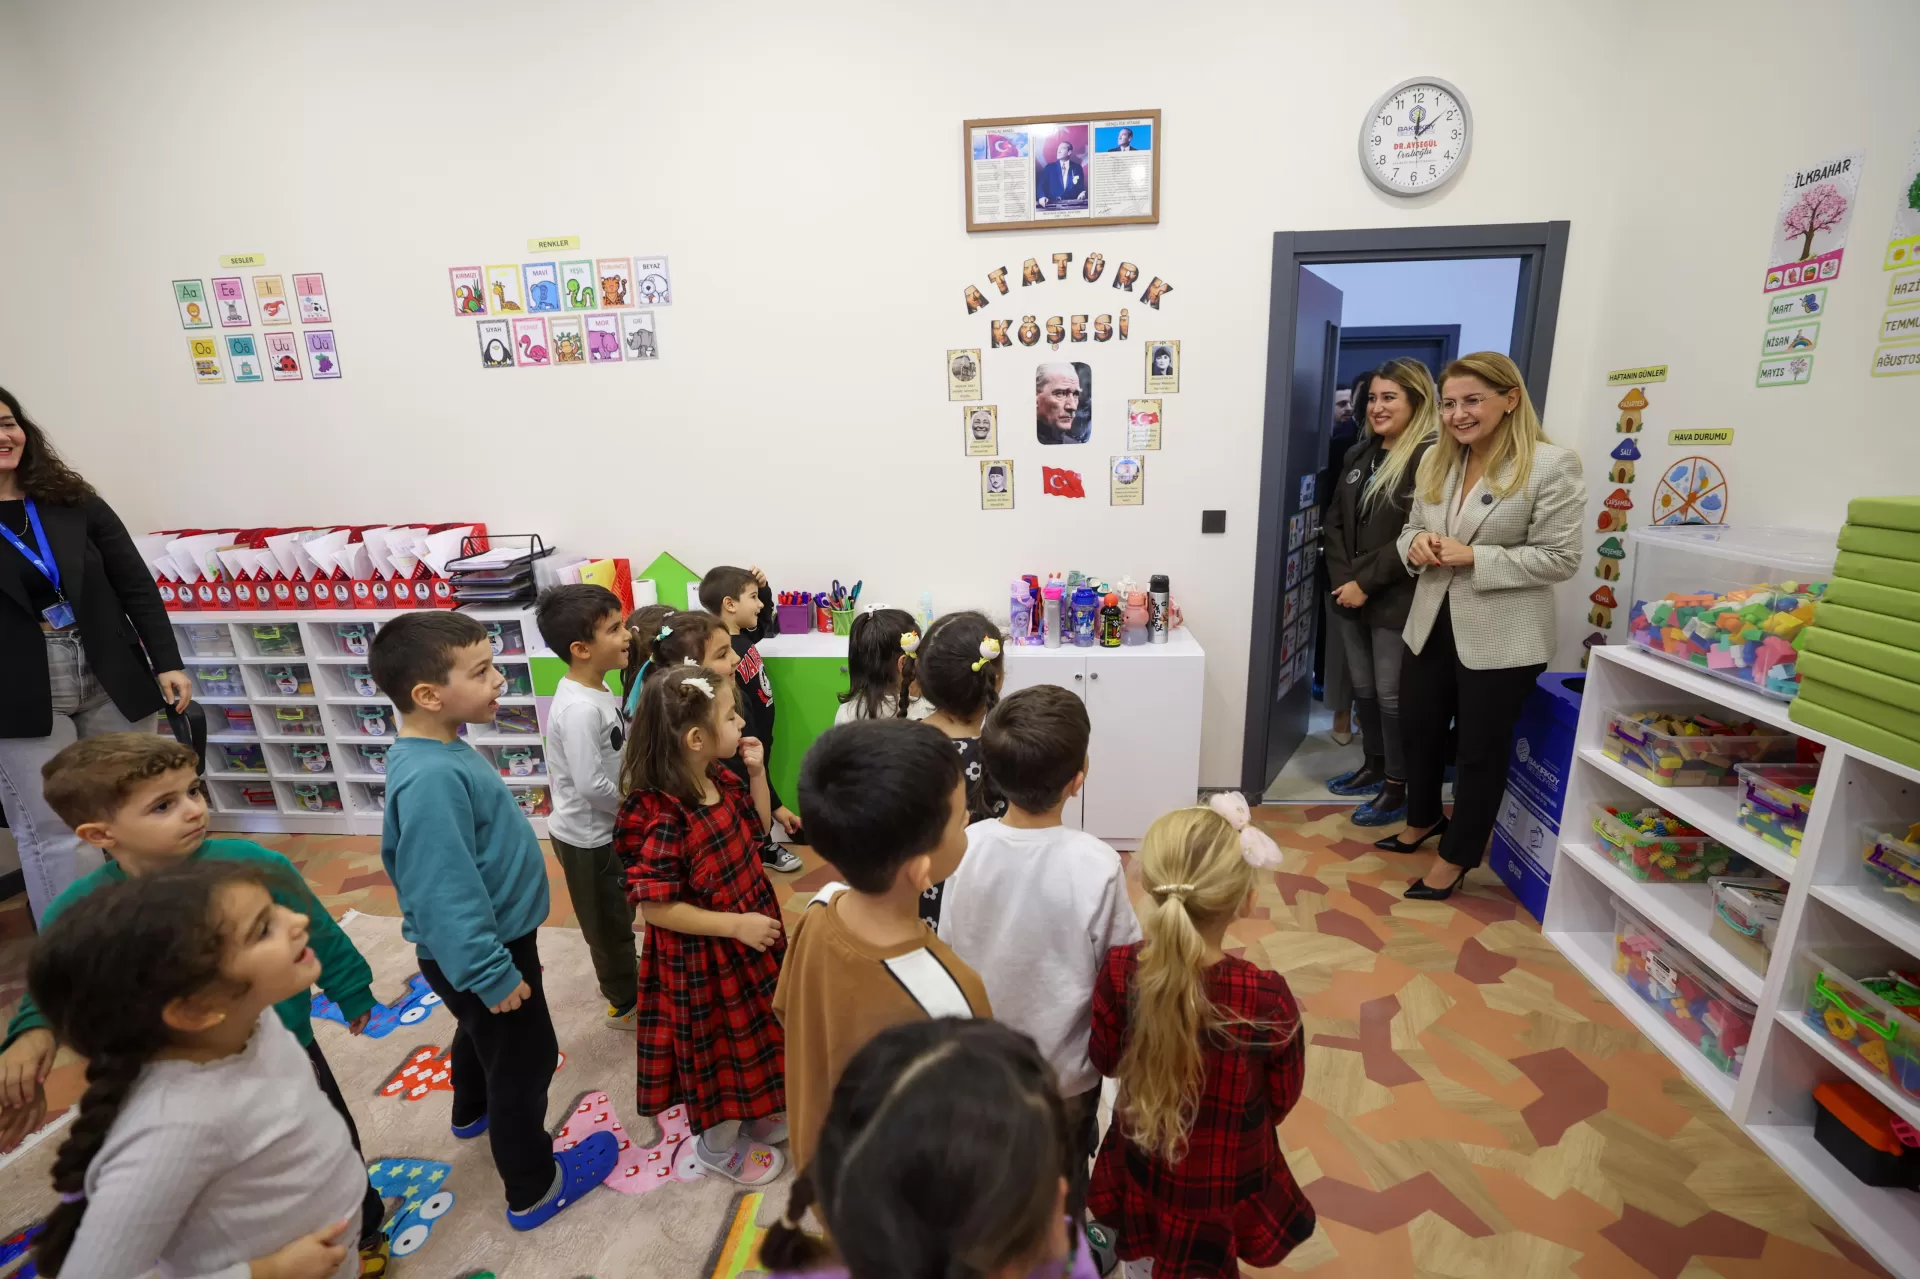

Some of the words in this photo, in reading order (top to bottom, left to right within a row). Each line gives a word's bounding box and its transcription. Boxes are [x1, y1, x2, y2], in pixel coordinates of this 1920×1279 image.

[1413, 93, 1425, 103] 12
[1396, 100, 1404, 110] 11
[1382, 115, 1392, 126] 10
[1446, 110, 1454, 121] 2
[1450, 129, 1458, 140] 3
[1374, 136, 1382, 146] 9
[1380, 154, 1386, 165] 8
[1444, 150, 1450, 160] 4
[1393, 168, 1400, 178] 7
[1428, 164, 1436, 174] 5
[1794, 159, 1852, 188] İLKBAHAR
[1410, 172, 1418, 182] 6
[538, 239, 569, 248] RENKLER
[963, 252, 1174, 315] ATATÜRK
[182, 286, 197, 298] Aa
[220, 283, 235, 296] Ee
[1771, 303, 1794, 315] MART
[990, 308, 1130, 351] KÖŞESİ
[234, 338, 250, 354] Öö
[272, 339, 290, 352] Uu
[312, 334, 330, 350] Üü
[1766, 334, 1790, 347] NİSAN
[195, 342, 212, 354] Oo
[1609, 372, 1639, 381] HAFTANIN
[1638, 368, 1666, 378] GÜNLERİ
[1760, 367, 1784, 378] MAYIS
[1620, 400, 1645, 408] PAZARTESİ
[1674, 433, 1692, 441] HAVA
[1694, 432, 1728, 441] DURUMU
[1620, 448, 1632, 456] SALI
[1606, 499, 1632, 508] ÇARŞAMBA
[1600, 546, 1622, 556] PERŞEMBE
[1595, 594, 1609, 604] CUMA
